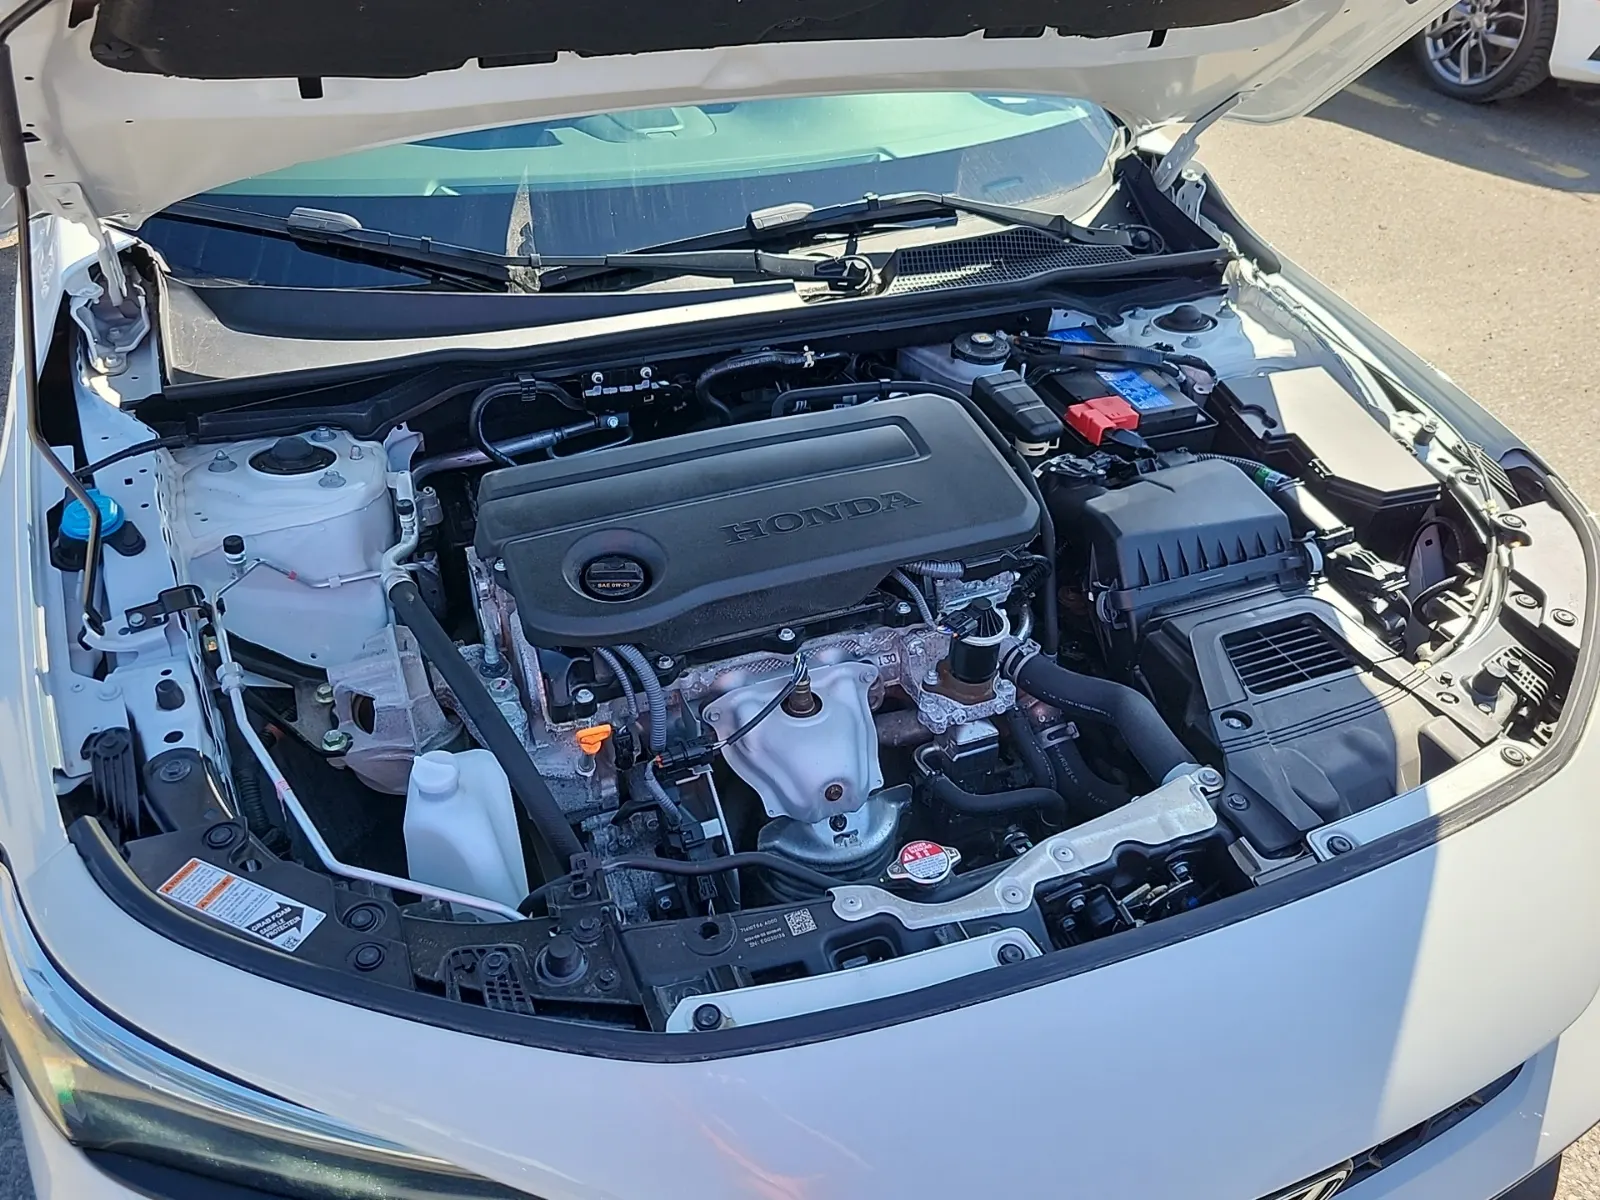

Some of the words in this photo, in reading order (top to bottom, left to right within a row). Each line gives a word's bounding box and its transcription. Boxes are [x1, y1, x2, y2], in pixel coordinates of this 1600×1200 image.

[719, 490, 924, 546] HONDA
[251, 917, 272, 932] GRAB
[271, 906, 292, 921] FOAM
[265, 916, 302, 939] PROTECTEUR
[277, 918, 286, 927] LE
